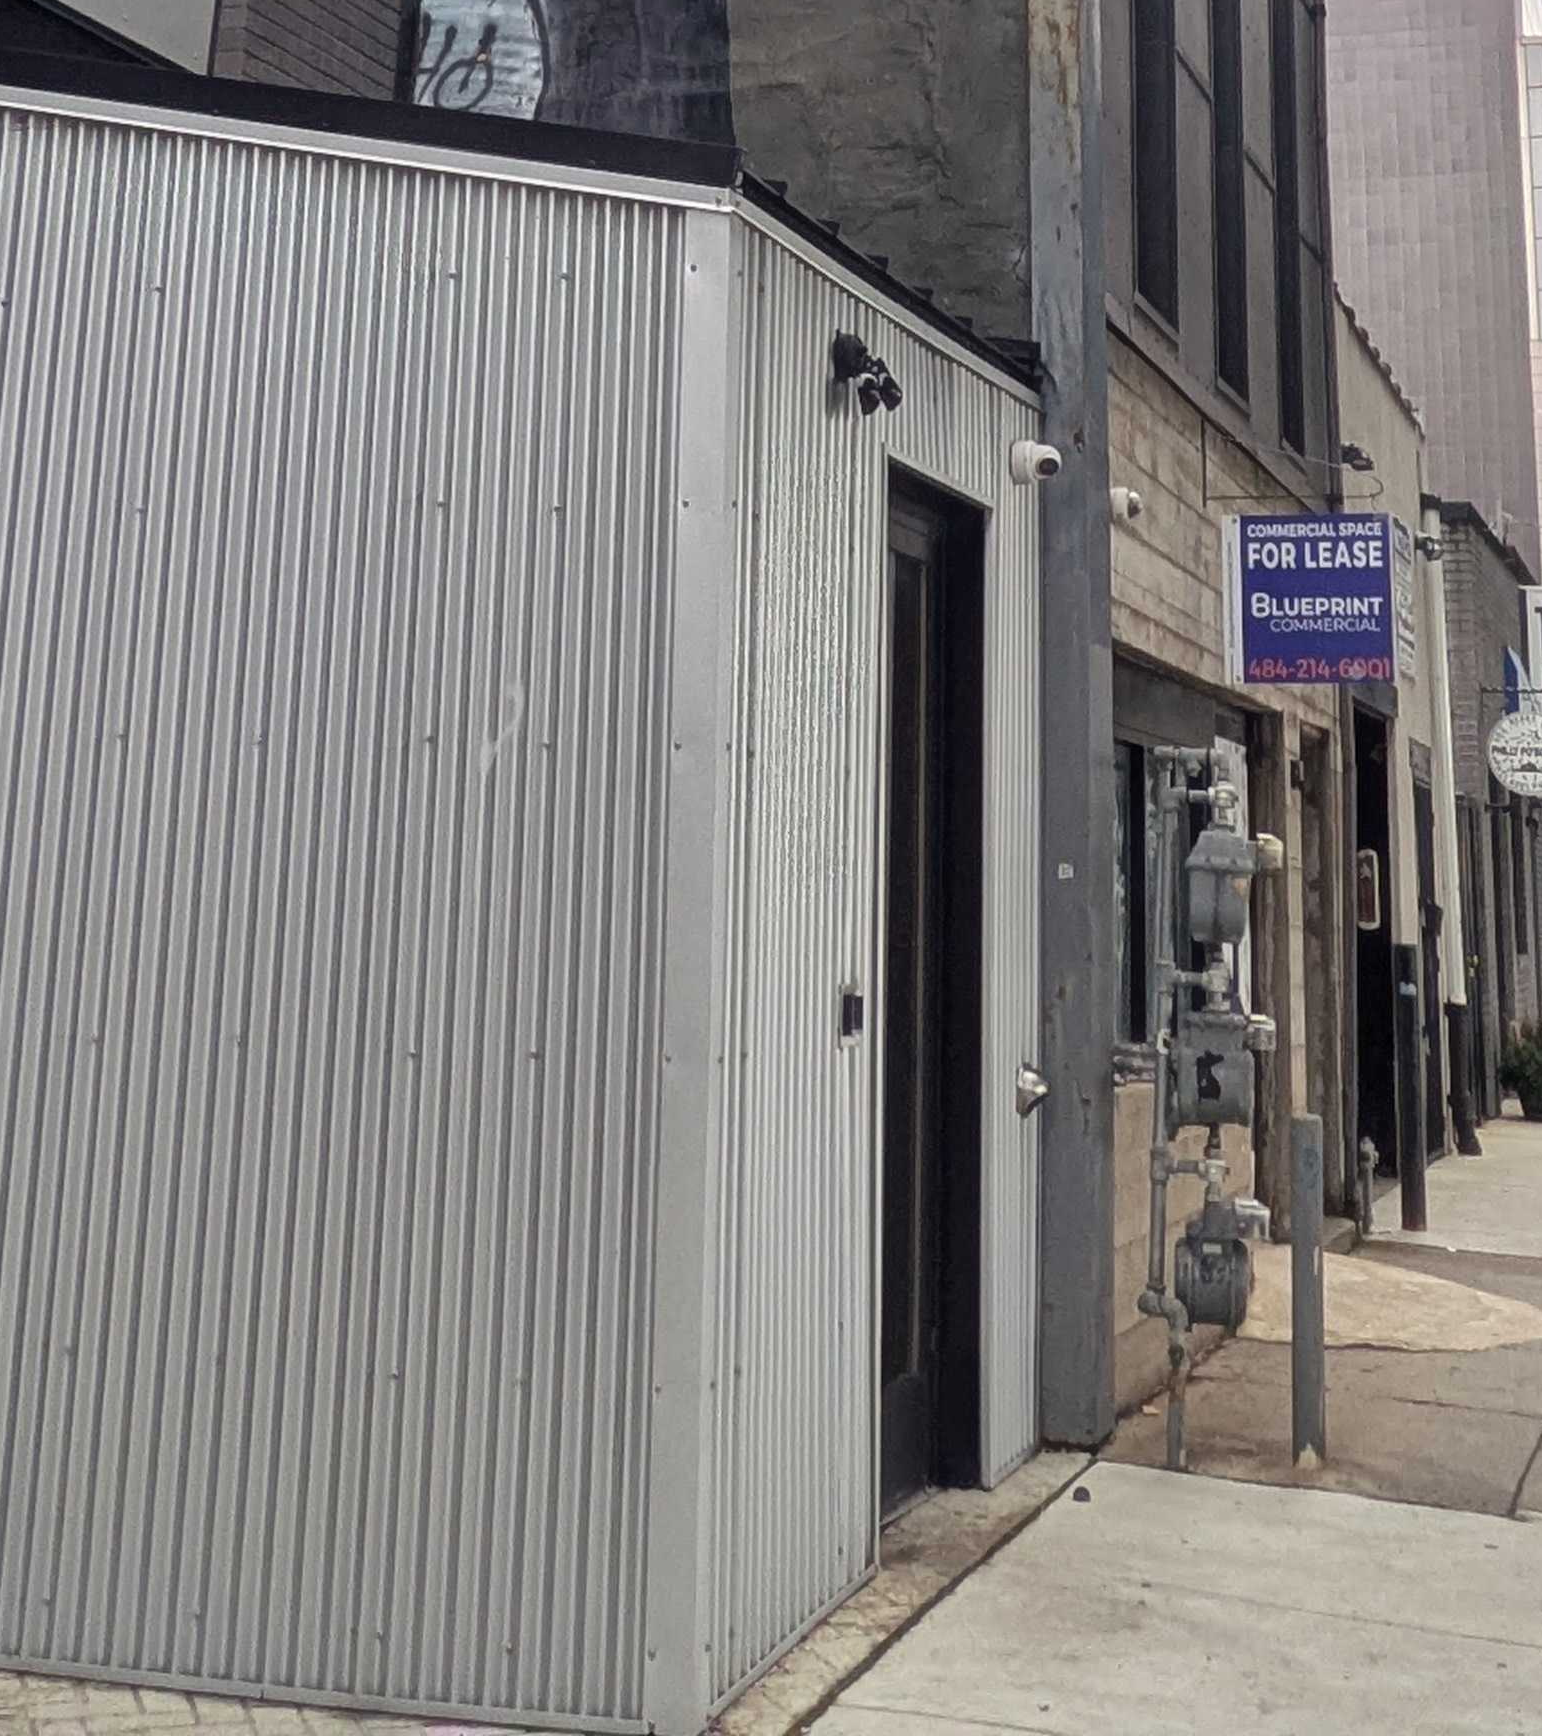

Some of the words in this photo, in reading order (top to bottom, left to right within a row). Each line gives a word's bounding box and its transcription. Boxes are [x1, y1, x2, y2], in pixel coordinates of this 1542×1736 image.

[1247, 522, 1336, 538] COMMERCIAL
[1339, 521, 1382, 537] SPACE
[1247, 542, 1296, 570] FOR
[1304, 540, 1383, 569] LEASE
[1250, 592, 1384, 618] BLUEPRINT
[1270, 618, 1381, 633] COMMERCIAL
